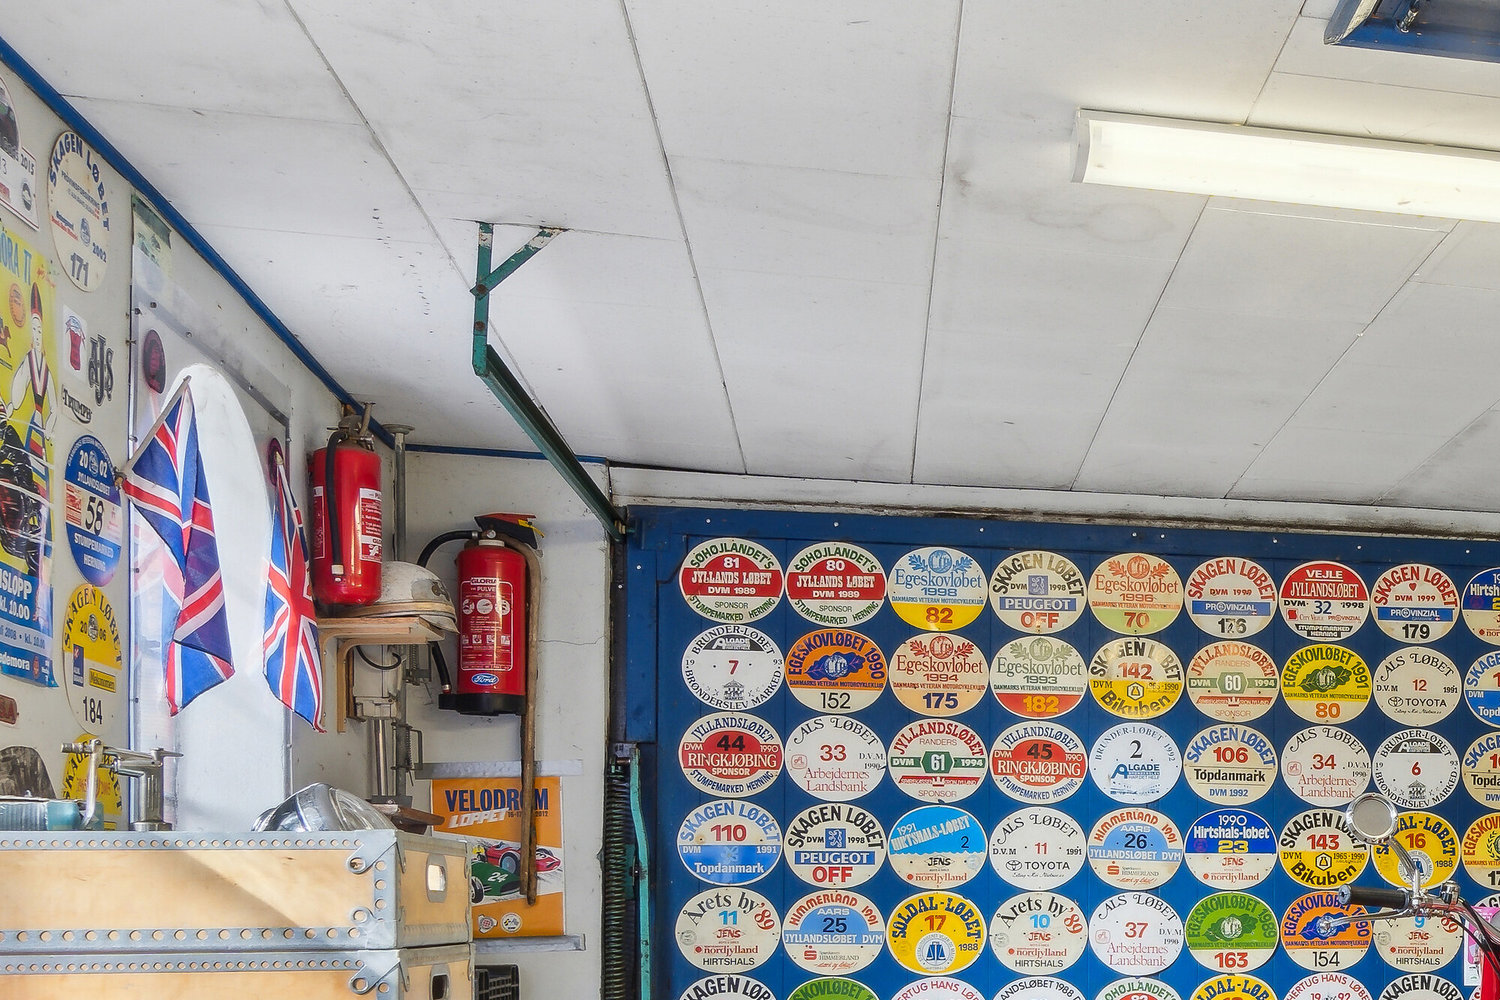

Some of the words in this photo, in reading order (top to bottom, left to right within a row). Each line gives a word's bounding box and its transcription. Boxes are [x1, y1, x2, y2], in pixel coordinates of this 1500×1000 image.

[70, 252, 88, 287] 171
[85, 496, 105, 536] 58
[690, 543, 775, 569] SØHØJLANDET'S
[723, 558, 740, 568] 81
[826, 560, 845, 571] 80
[692, 570, 739, 584] JYLLANDS
[743, 573, 771, 584] LØBET
[895, 568, 982, 593] Egeskovløbet
[992, 553, 1043, 594] SKAGEN
[1047, 553, 1085, 597] LØBET
[1306, 569, 1343, 579] VEJLE
[1095, 576, 1178, 595] Egeskovløbet
[1290, 582, 1359, 598] JYLLANDSLØBET
[1374, 566, 1420, 606] SKAGEN
[1423, 566, 1458, 607] LØBET
[689, 596, 743, 621] STUMPEMARKED
[748, 598, 776, 618] HERNING
[1005, 599, 1071, 610] PEUGEOT
[1314, 601, 1332, 614] 32
[926, 608, 953, 623] 82
[1021, 612, 1060, 628] OFF
[1124, 612, 1149, 627] 70
[1402, 623, 1430, 639] 179
[692, 625, 775, 655] BRUNDER-LØBET
[788, 633, 868, 676] EGESKOVLØBET
[865, 647, 885, 679] 1990
[729, 660, 739, 675] 7
[997, 657, 1082, 677] Egeskovløbet
[1117, 663, 1153, 680] 142
[472, 674, 497, 684] Ford
[923, 674, 958, 682] 1994
[1224, 674, 1241, 691] 60
[686, 671, 749, 710] BRØNDERSLEV
[752, 671, 781, 707] MARKED
[820, 693, 851, 709] 152
[923, 693, 959, 709] 175
[1022, 696, 1060, 713] 182
[1100, 690, 1171, 716] Bikuben
[1405, 698, 1447, 708] TOYOTA
[83, 696, 103, 725] 184
[1315, 702, 1341, 718] 80
[691, 717, 775, 741] JYLLANDSLØBET
[717, 735, 746, 751] 44
[1026, 743, 1053, 759] 45
[688, 753, 777, 768] RINGKJØBING
[820, 745, 847, 761] 33
[1213, 747, 1249, 763] 106
[930, 754, 946, 770] 61
[998, 760, 1081, 776] RINGKJØBING
[1411, 761, 1421, 775] 6
[804, 767, 870, 780] Arbejdernes
[1194, 769, 1266, 782] Topdanmark
[807, 780, 868, 792] Landsbank
[445, 788, 548, 812] VELODRM
[448, 808, 509, 829] LOPPET
[680, 801, 736, 842] SKAGEN
[738, 802, 782, 842] LØBET
[710, 825, 747, 841] 110
[1193, 826, 1270, 839] Hirtshals-løbet
[1124, 834, 1148, 849] 26
[1306, 834, 1340, 850] 143
[800, 852, 869, 864] PEUGEOT
[1089, 848, 1158, 860] JYLLANDSLØBET
[1162, 852, 1181, 860] DVM
[694, 862, 764, 874] Topdanmark
[1025, 861, 1070, 870] TOYOTA
[488, 872, 509, 882] 24
[812, 866, 854, 882] OFF
[914, 872, 968, 883] nordjylland
[1292, 861, 1358, 887] Bikuben
[822, 918, 848, 933] 25
[924, 915, 946, 931] 17
[702, 957, 755, 966] HIRTSHALS
[1214, 952, 1248, 968] 163
[1312, 951, 1340, 967] 154
[931, 982, 959, 992] HANS
